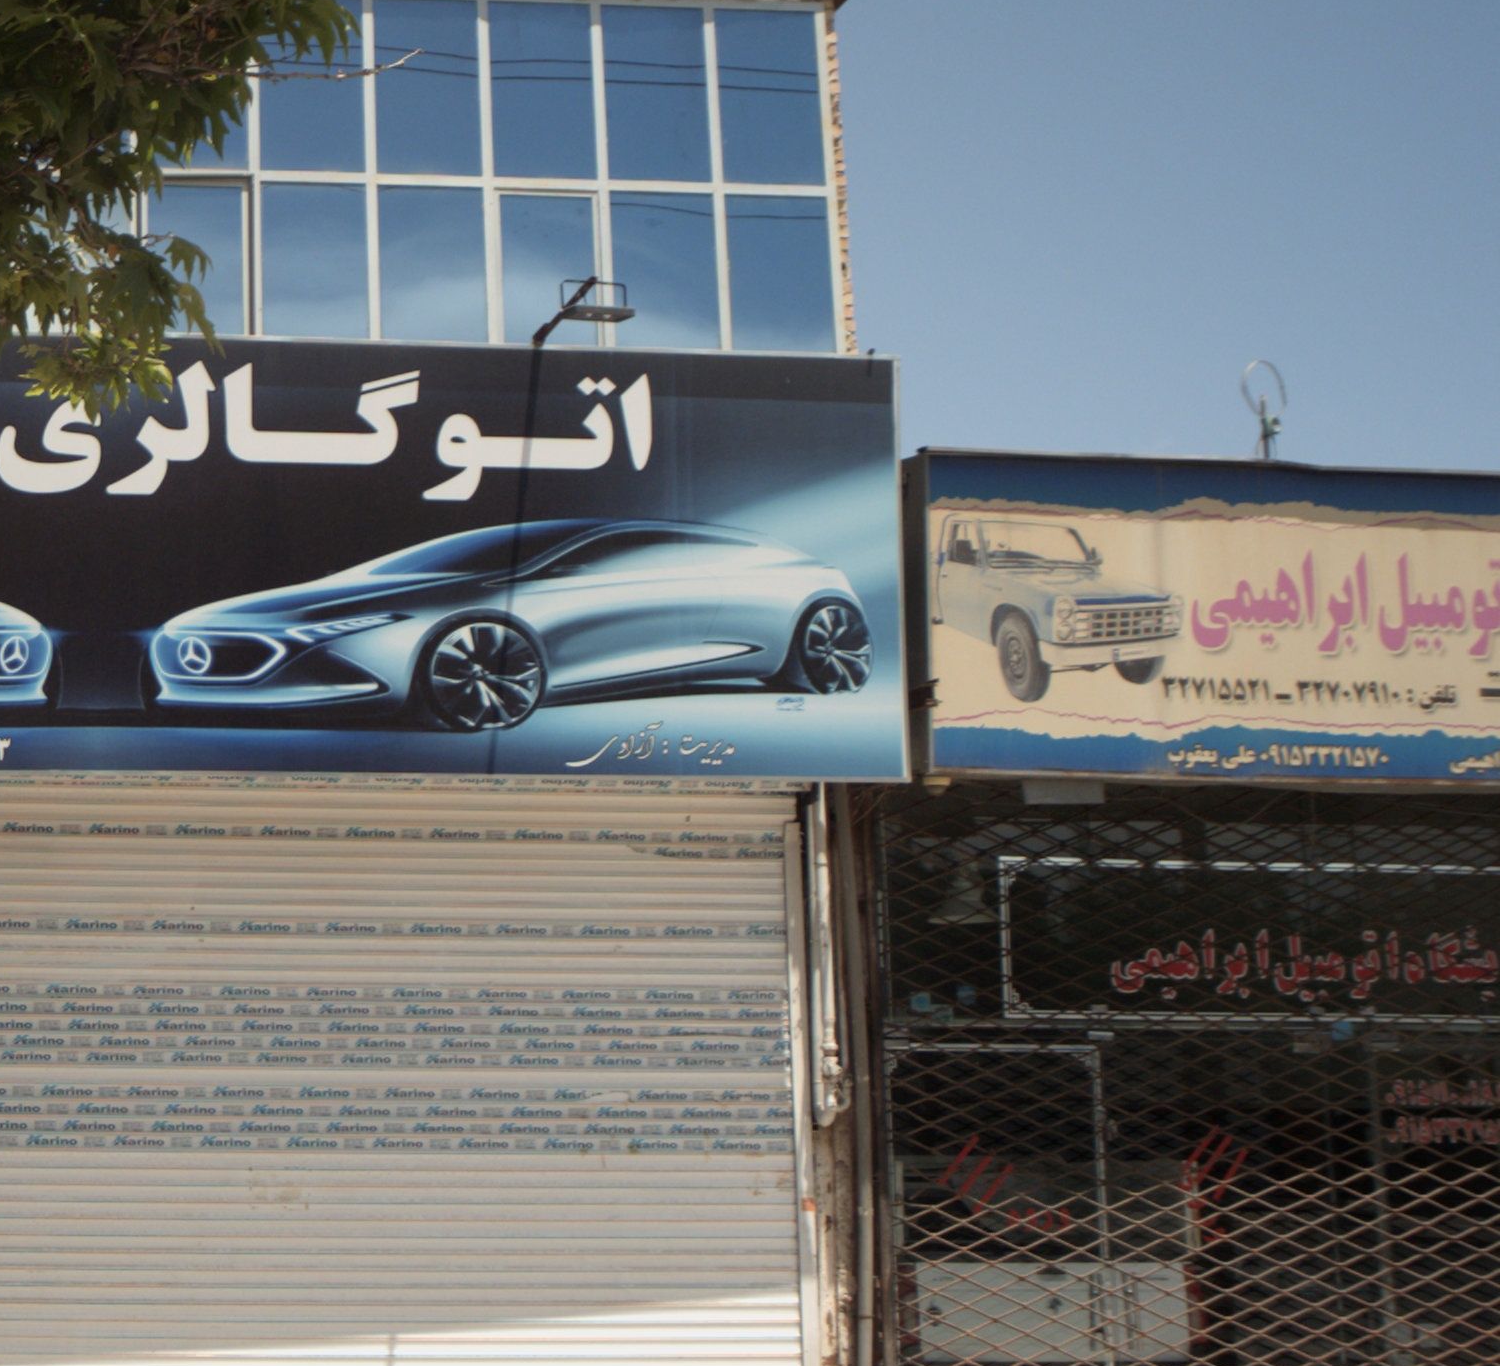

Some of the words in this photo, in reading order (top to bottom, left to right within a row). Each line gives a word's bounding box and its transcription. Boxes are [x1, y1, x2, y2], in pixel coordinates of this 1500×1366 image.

[1190, 550, 1371, 656] ابراهیمی
[565, 721, 662, 767] آزادی
[679, 734, 736, 765] مدیریت
